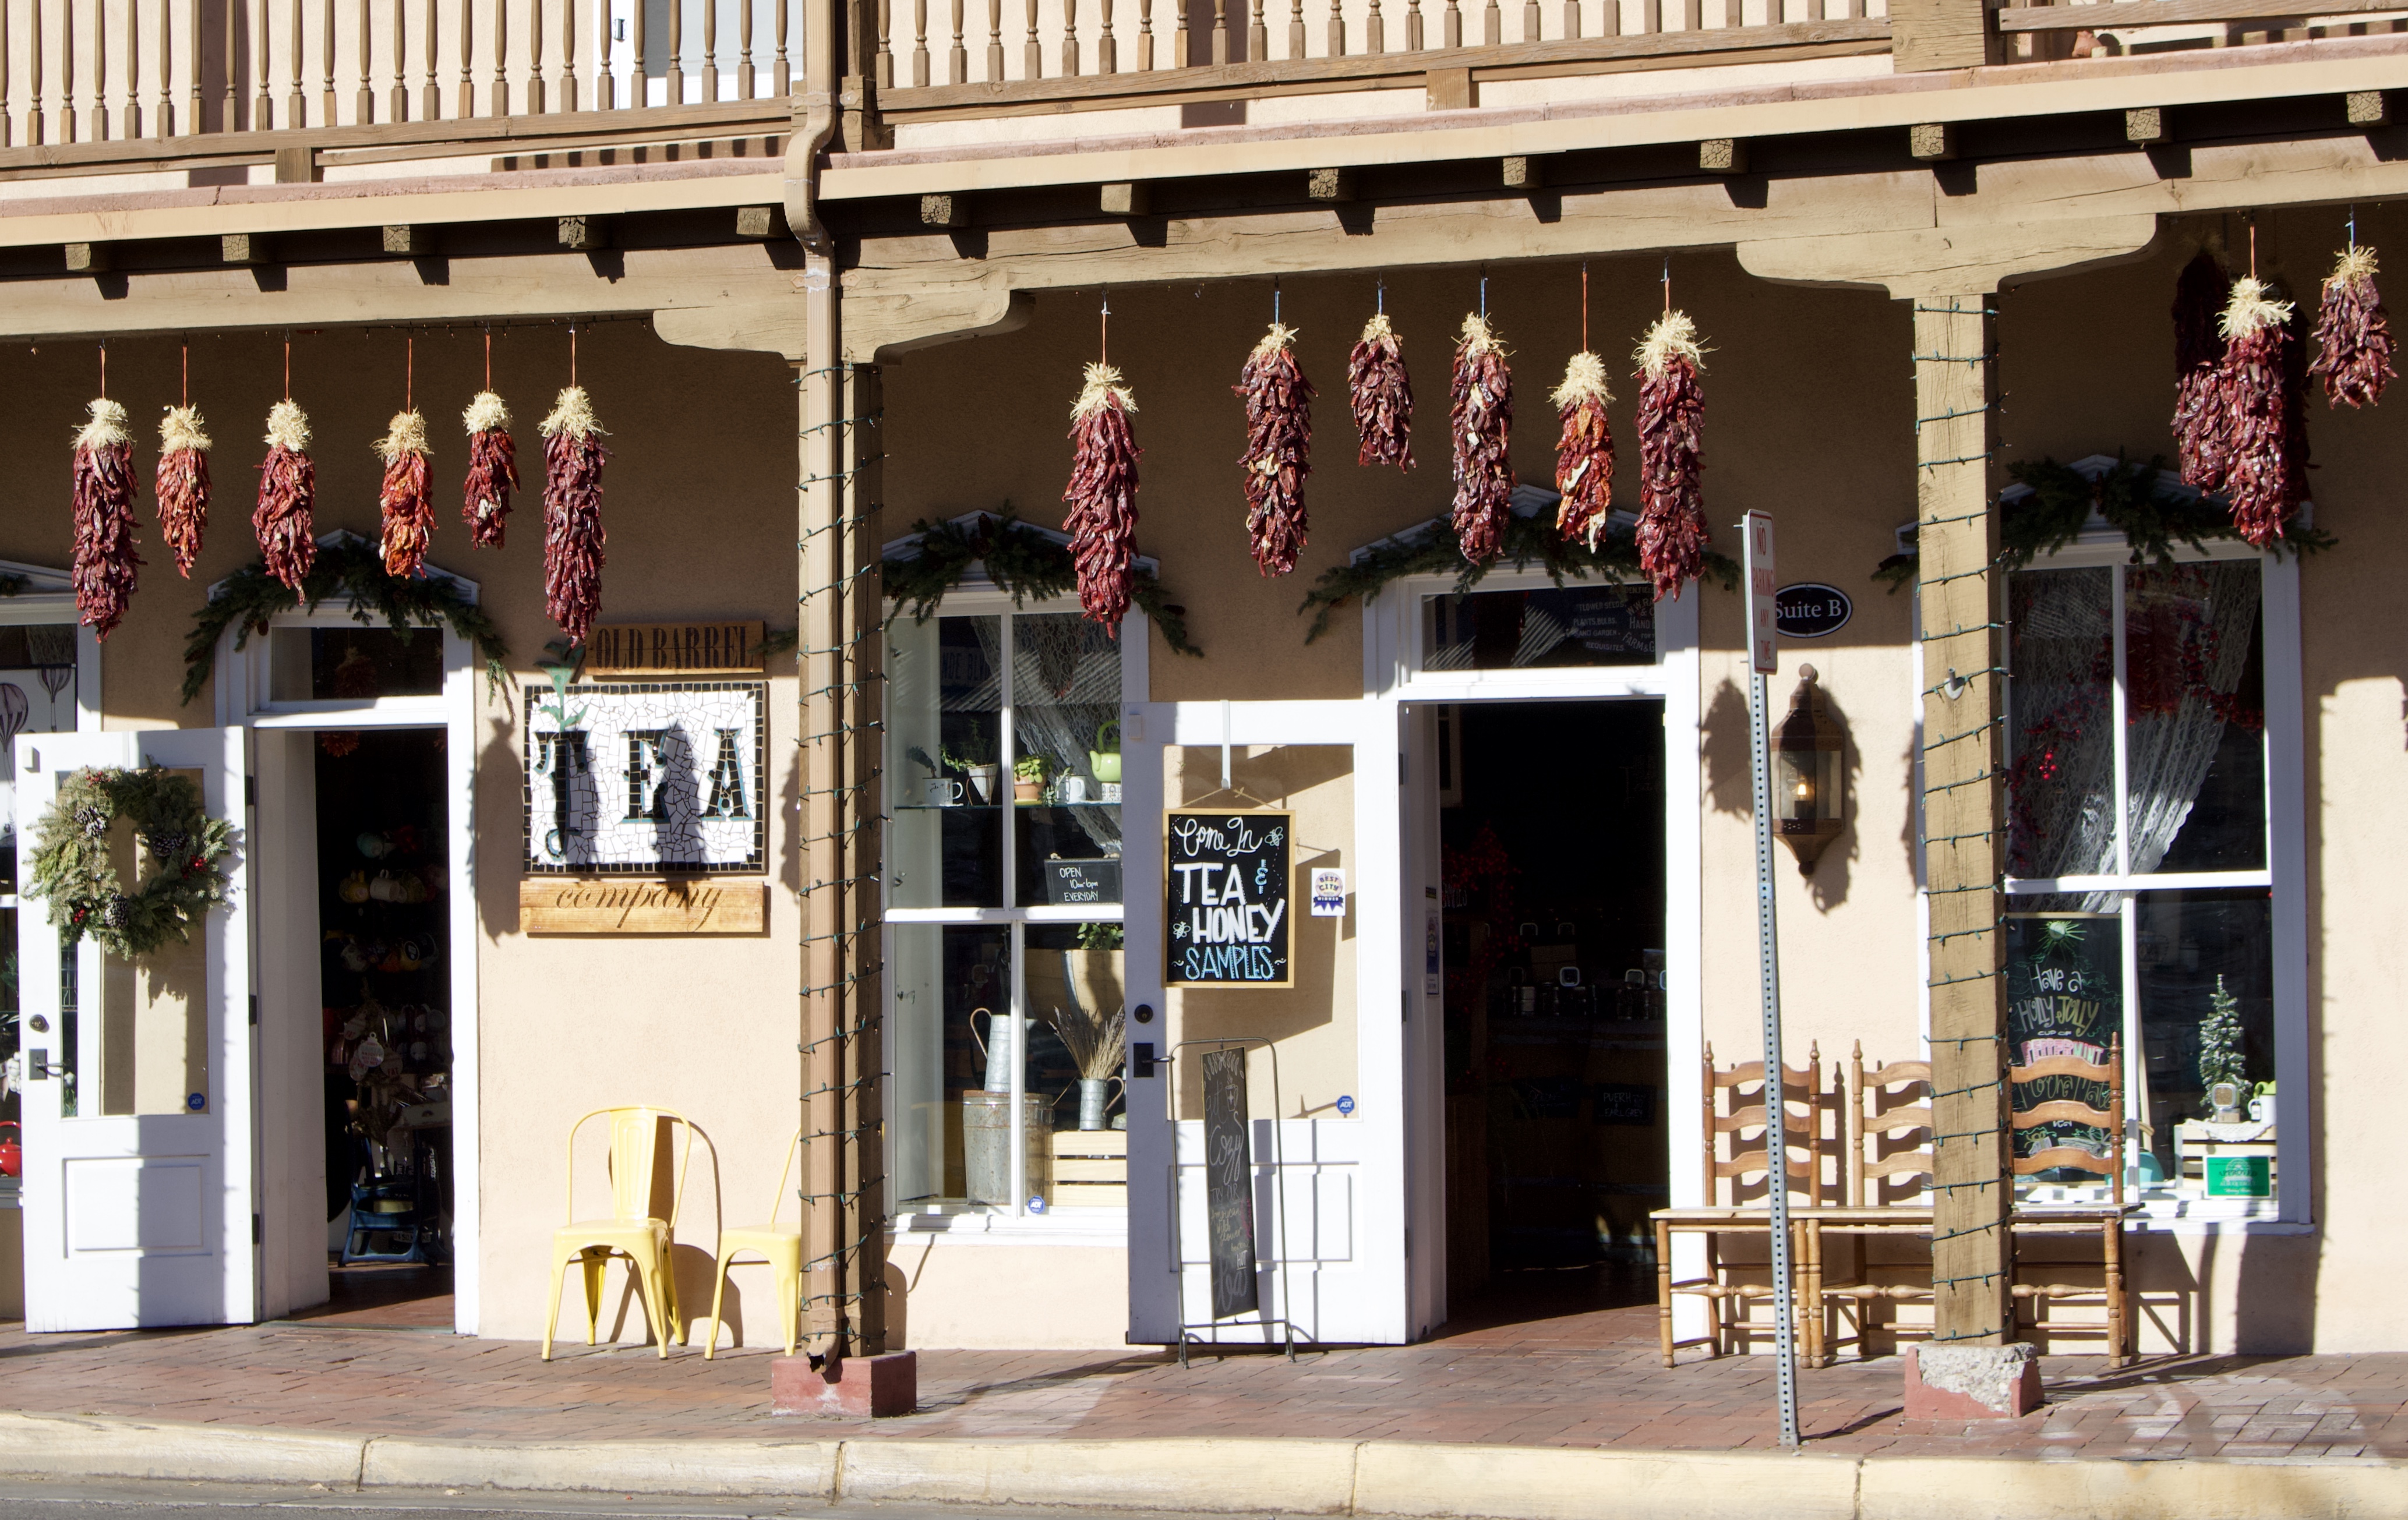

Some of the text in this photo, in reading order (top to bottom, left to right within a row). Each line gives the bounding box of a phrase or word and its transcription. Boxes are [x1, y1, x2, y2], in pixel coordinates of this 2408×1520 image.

[1757, 527, 1766, 556] NO
[1753, 567, 1774, 597] PARKING
[1629, 616, 1650, 629] HAND
[1760, 609, 1768, 627] ANY
[1776, 599, 1842, 619] Suite B
[596, 625, 754, 670] OLD BARREL
[1761, 640, 1771, 659] TIME
[534, 729, 754, 861] TEA
[1174, 816, 1263, 857] Come In
[1059, 867, 1082, 878] OPEN
[1174, 859, 1268, 906] TEA &
[555, 882, 723, 934] company
[1064, 890, 1099, 902] EVERYDAY
[1192, 898, 1286, 945] HONEY
[1185, 945, 1275, 980] SAMPLES
[2027, 963, 2082, 994] Have a
[1236, 1250, 1248, 1268] HOT
